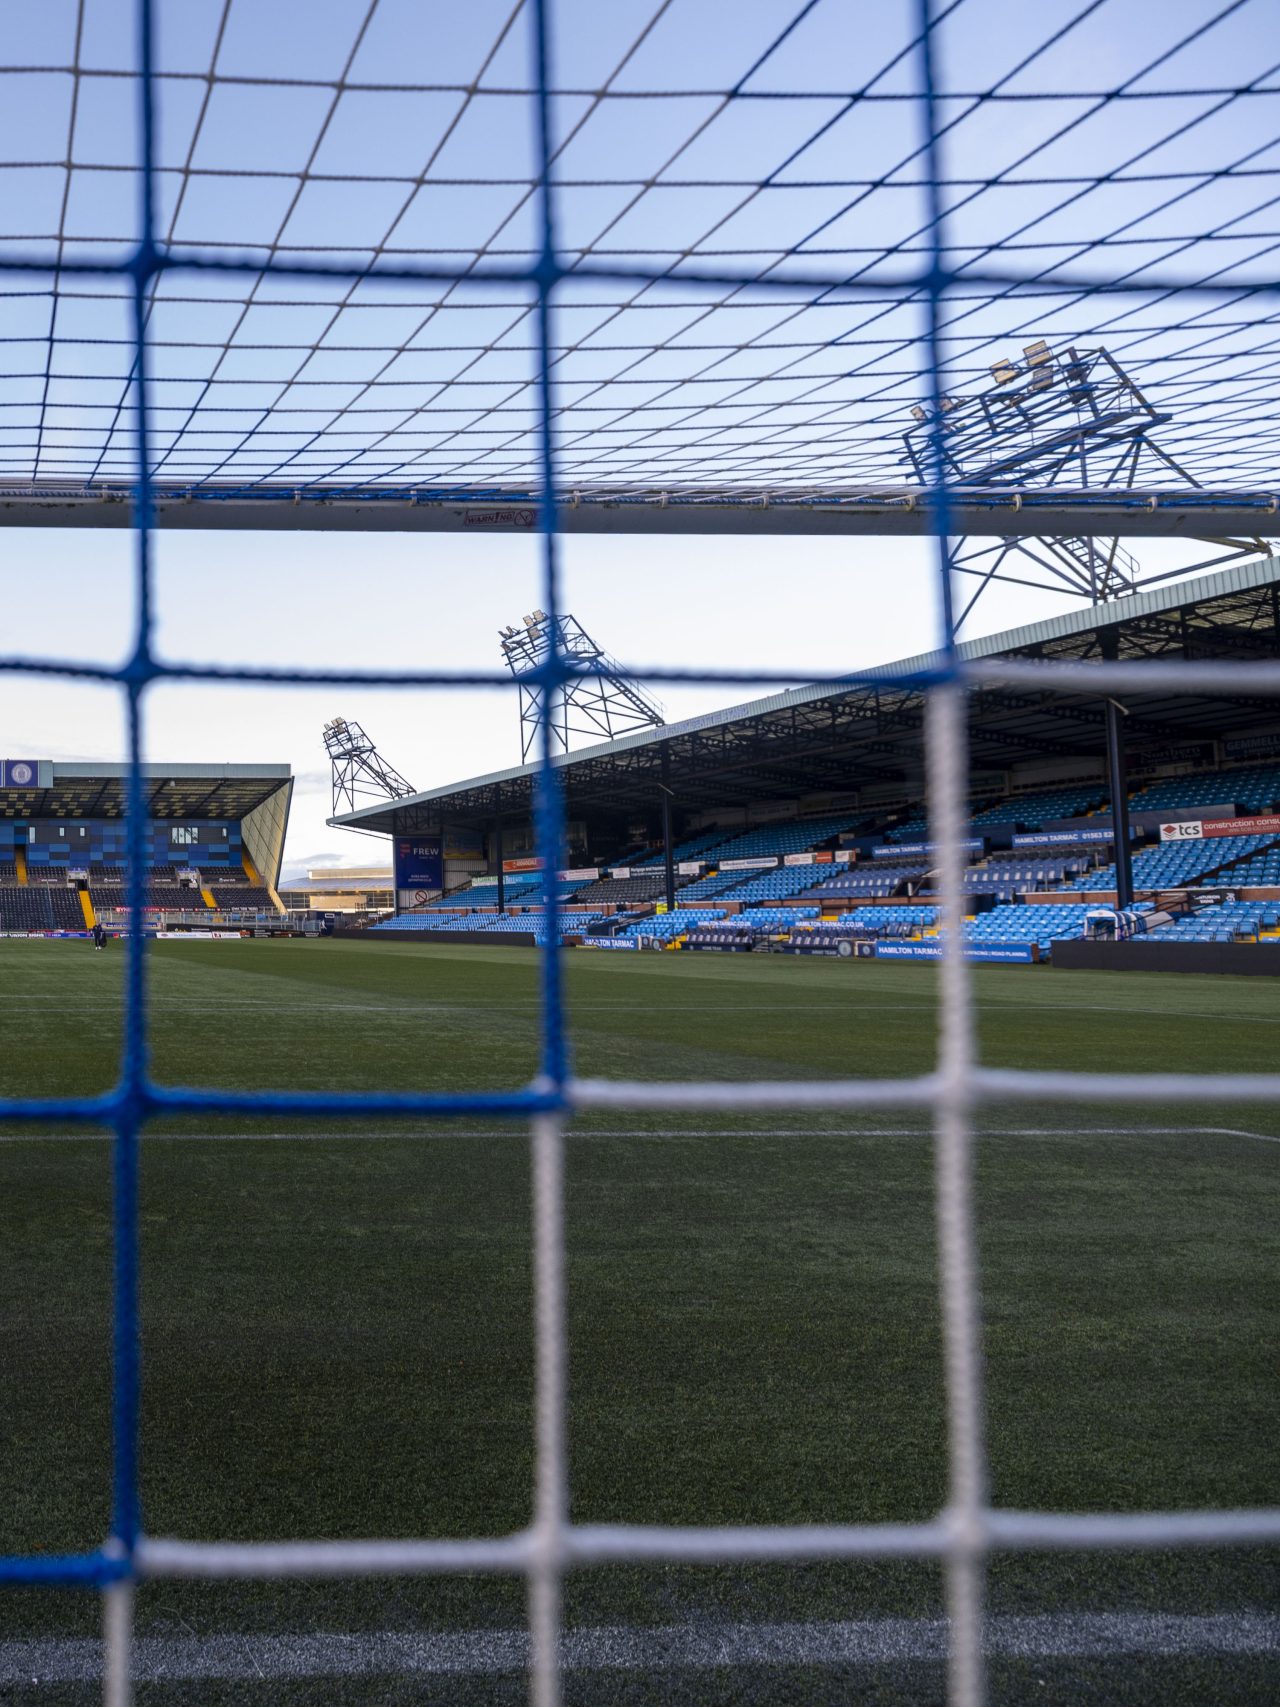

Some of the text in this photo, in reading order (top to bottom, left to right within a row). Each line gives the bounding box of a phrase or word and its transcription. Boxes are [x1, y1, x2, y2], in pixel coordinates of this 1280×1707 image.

[1179, 825, 1200, 836] tcs
[1204, 820, 1254, 829] construction
[413, 848, 439, 856] FREW
[611, 938, 634, 948] TARMAC
[914, 948, 943, 956] TARMAC
